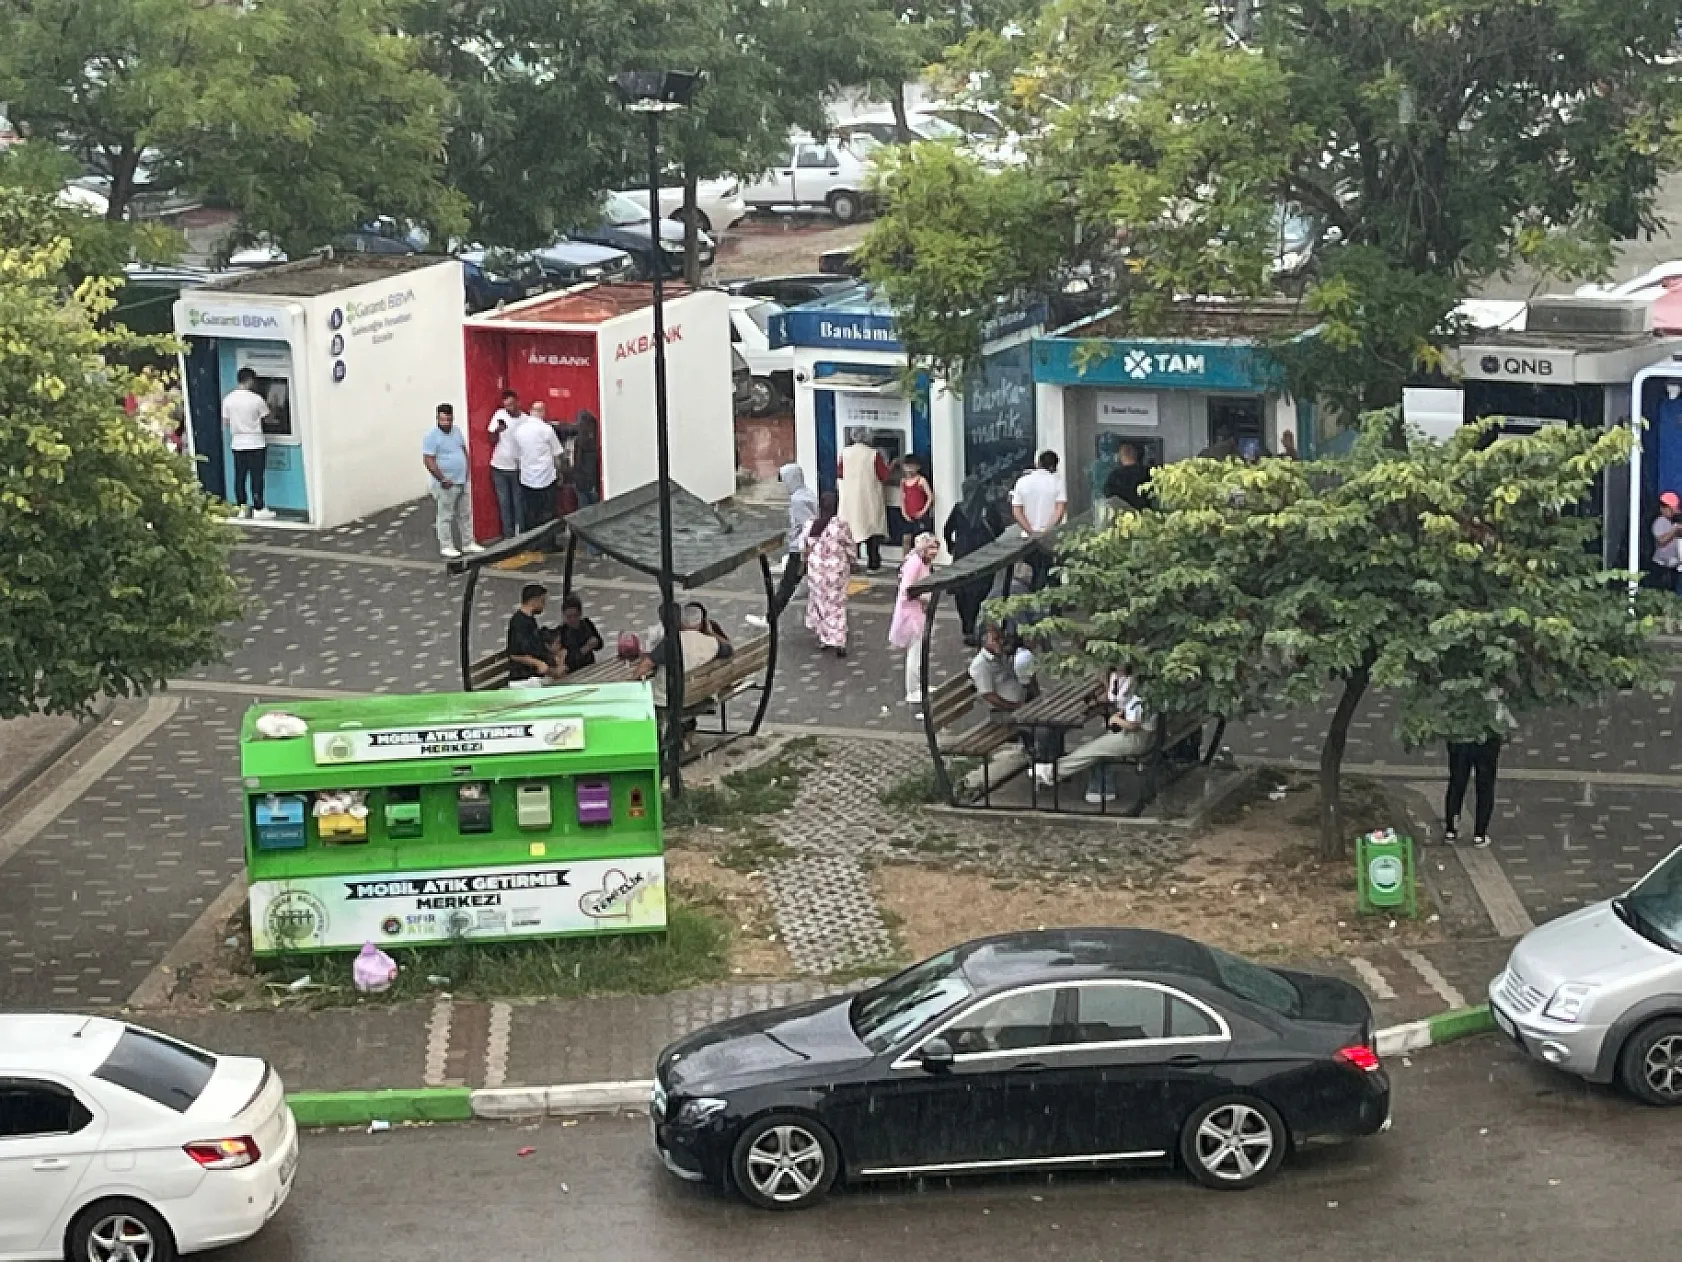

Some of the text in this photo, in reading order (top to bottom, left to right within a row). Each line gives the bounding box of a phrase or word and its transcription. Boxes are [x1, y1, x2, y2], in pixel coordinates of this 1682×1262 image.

[527, 353, 591, 367] AKBANK
[1155, 354, 1206, 374] TAM
[1504, 358, 1553, 376] QNB
